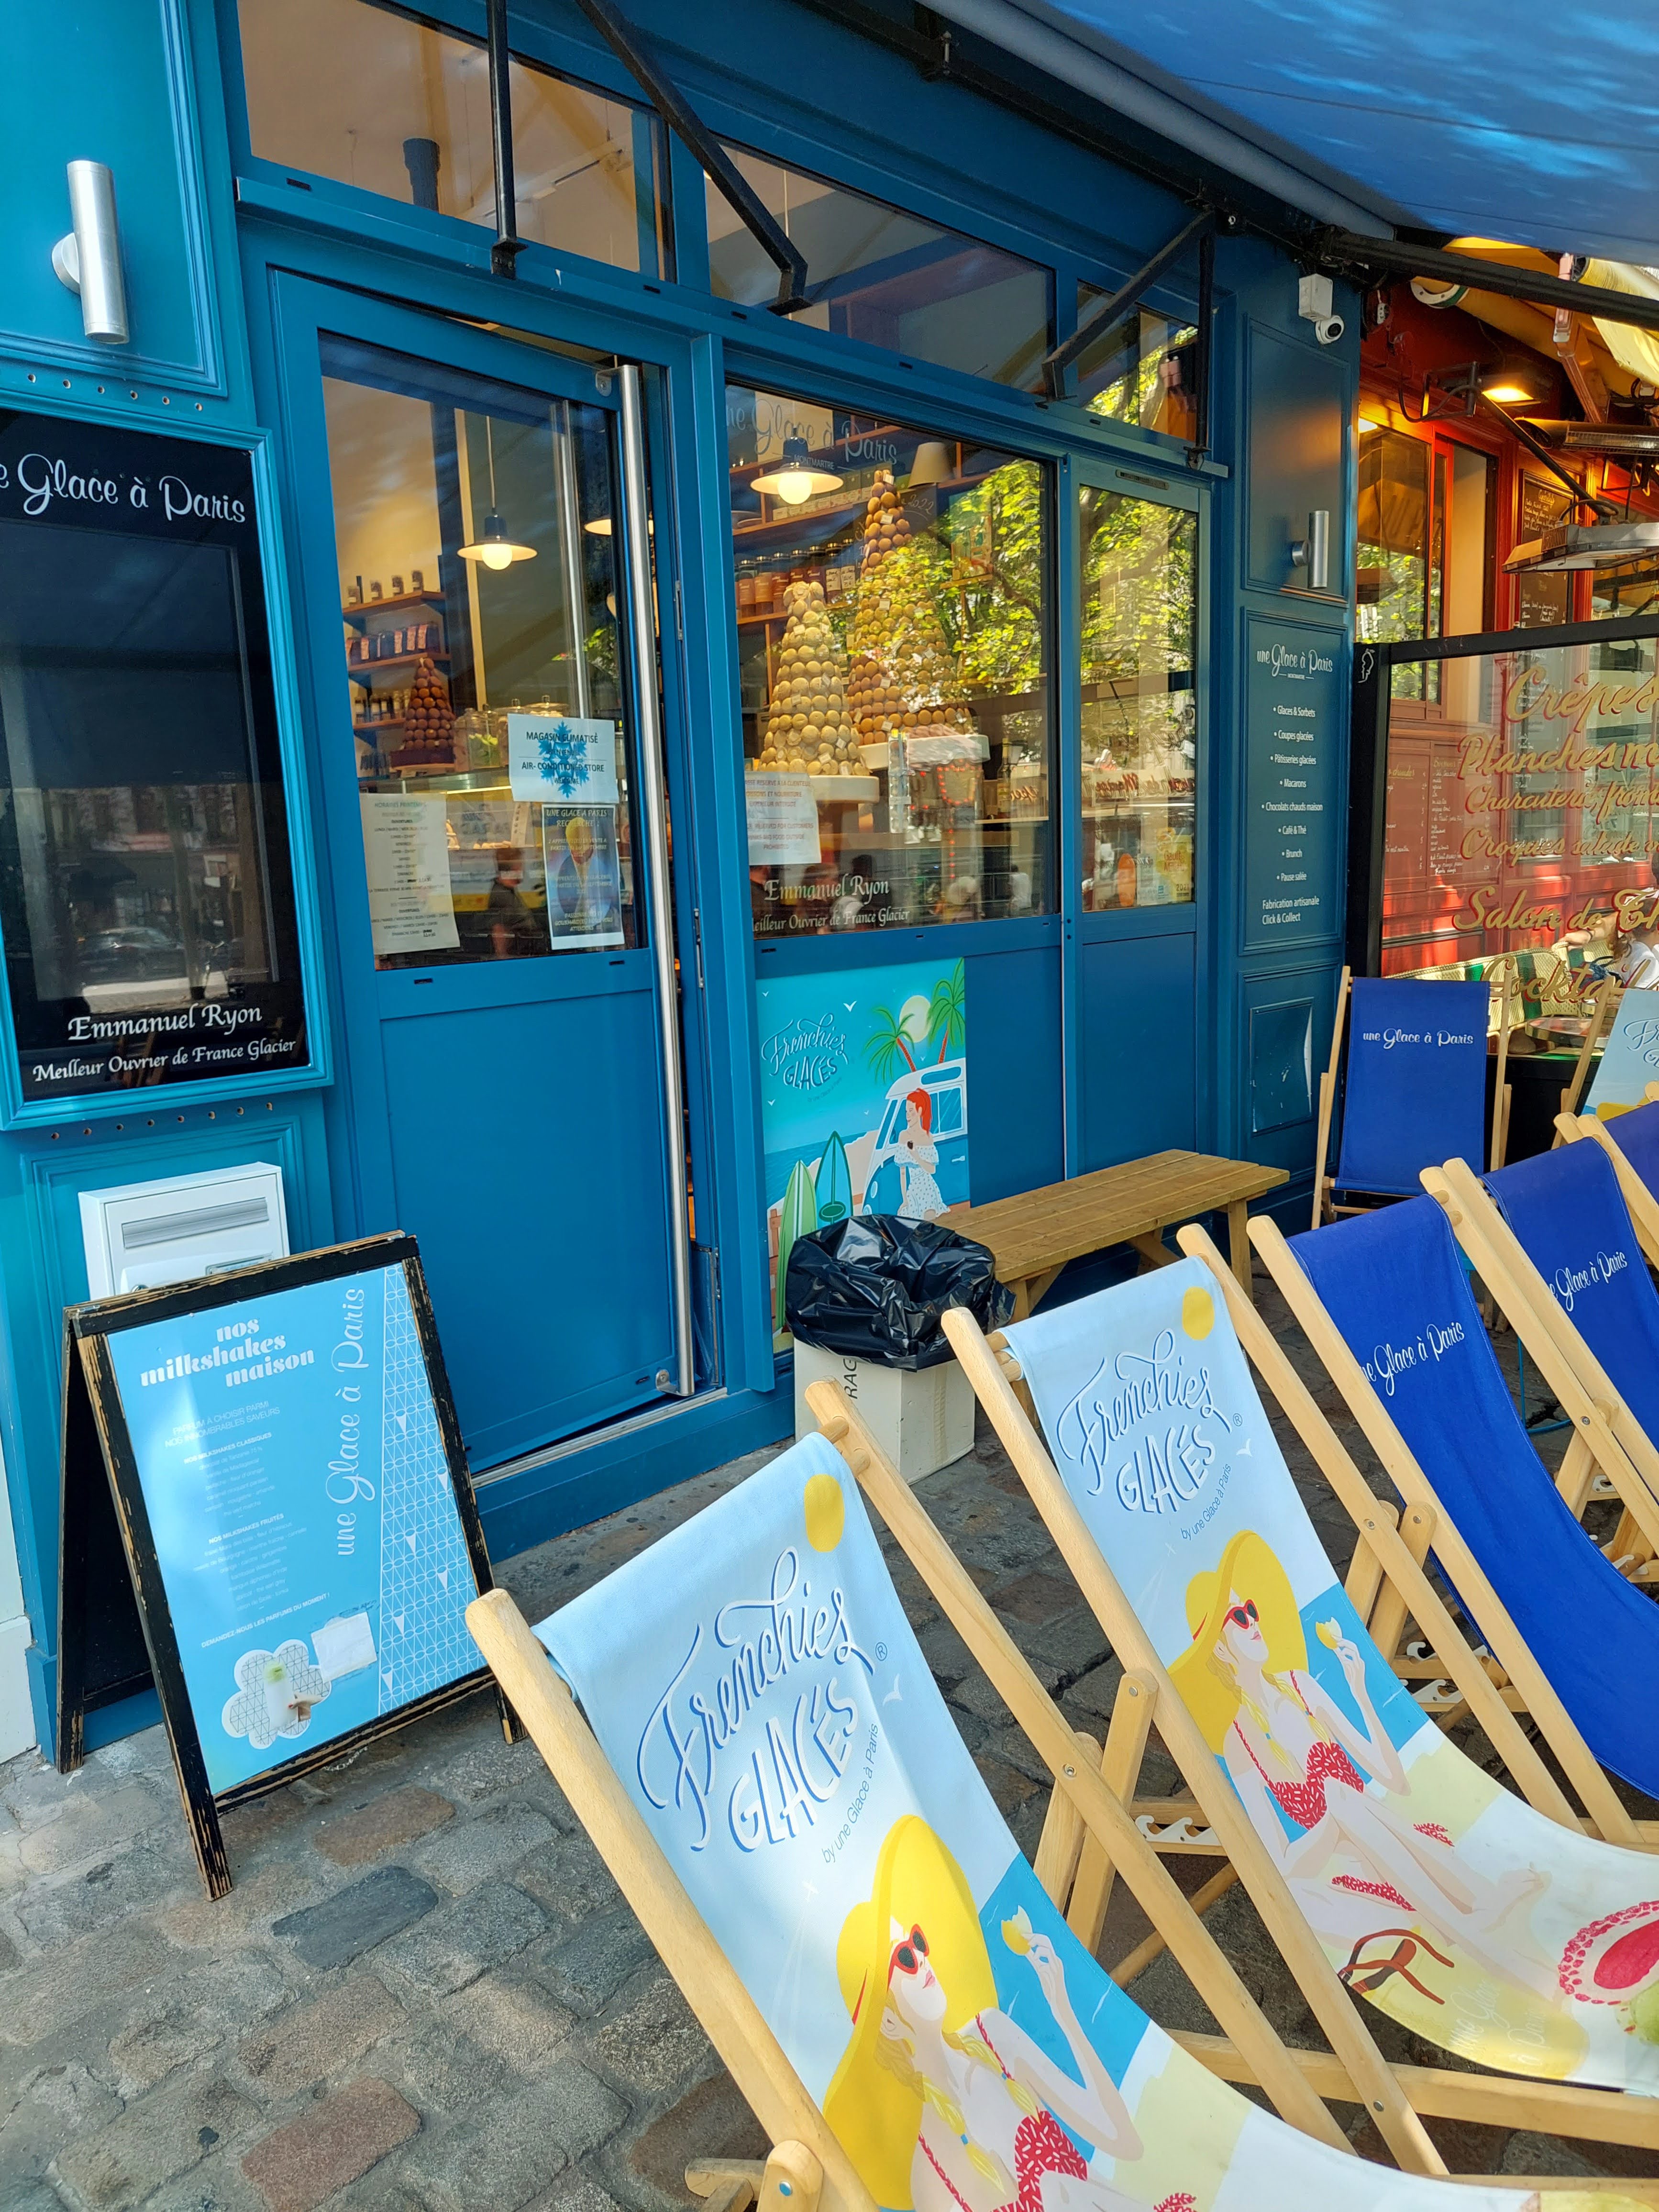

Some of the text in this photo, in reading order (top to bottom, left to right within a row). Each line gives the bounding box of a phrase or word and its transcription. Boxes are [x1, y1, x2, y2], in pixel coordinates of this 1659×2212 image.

[728, 398, 897, 465] ne Glace à Paris
[794, 454, 834, 470] MONTMARTRE
[18, 453, 118, 515] Glace
[130, 476, 149, 508] à
[159, 476, 245, 522] Paris
[1257, 644, 1333, 677] une Glace à Paris
[1277, 706, 1316, 718] Glaces & Sorbets
[526, 731, 560, 741] MAGASIN
[1278, 730, 1314, 742] Coupes glacées
[584, 764, 605, 772] STORE
[1275, 753, 1316, 766] Pâtisseries glacées
[1457, 733, 1617, 780] Planches
[1284, 778, 1306, 787] Macarons
[1266, 802, 1323, 811] Chocolats chauds maison
[1283, 826, 1293, 835] Café
[1297, 825, 1306, 834] Thé
[1286, 849, 1302, 858] Brunch
[1460, 828, 1565, 868] Croques
[764, 873, 889, 905] Emmanuel Ryon
[1281, 872, 1306, 882] Pause salée
[1263, 896, 1319, 909] Fabrication artisanale
[1452, 886, 1563, 931] Salon
[1567, 898, 1603, 930] de
[752, 908, 910, 932] eilleur Ouvrier de France Glacier
[1262, 912, 1301, 925] Click & Collect
[68, 1004, 263, 1041] Emmanuel Ryon
[761, 1013, 848, 1076] Frenchies
[1383, 1029, 1420, 1049] Glace
[1424, 1032, 1432, 1043] à
[1437, 1030, 1473, 1047] Paris
[33, 1039, 296, 1082] Meilleur Ouvrier de France Glacier
[1555, 1269, 1591, 1312] Glace
[1591, 1261, 1599, 1283] à
[1597, 1250, 1627, 1284] Paris
[216, 1317, 260, 1342] nos
[140, 1334, 287, 1387] milkshakes
[225, 1349, 315, 1387] maison
[1360, 1322, 1464, 1396] ne Glace à Paris
[213, 1408, 244, 1422] CHOISIR
[246, 1400, 269, 1413] PARMI
[245, 1407, 281, 1423] SAVEURS
[325, 1288, 375, 1556] une Glace à Paris
[1057, 1328, 1233, 1496] Frenchies
[236, 1432, 272, 1447] CLASSIQUES
[1181, 1463, 1231, 1540] by une Glace à Paris
[208, 1535, 222, 1544] NOS
[222, 1522, 260, 1538] MILKSHAKES
[201, 1624, 253, 1648] DEMANDEZ-NOUS
[254, 1618, 265, 1626] LES
[265, 1608, 293, 1622] PARFUMS
[302, 1593, 327, 1607] MOMENT
[637, 1546, 876, 1852] Frenchies
[821, 1724, 878, 1863] by une Glace à Paris
